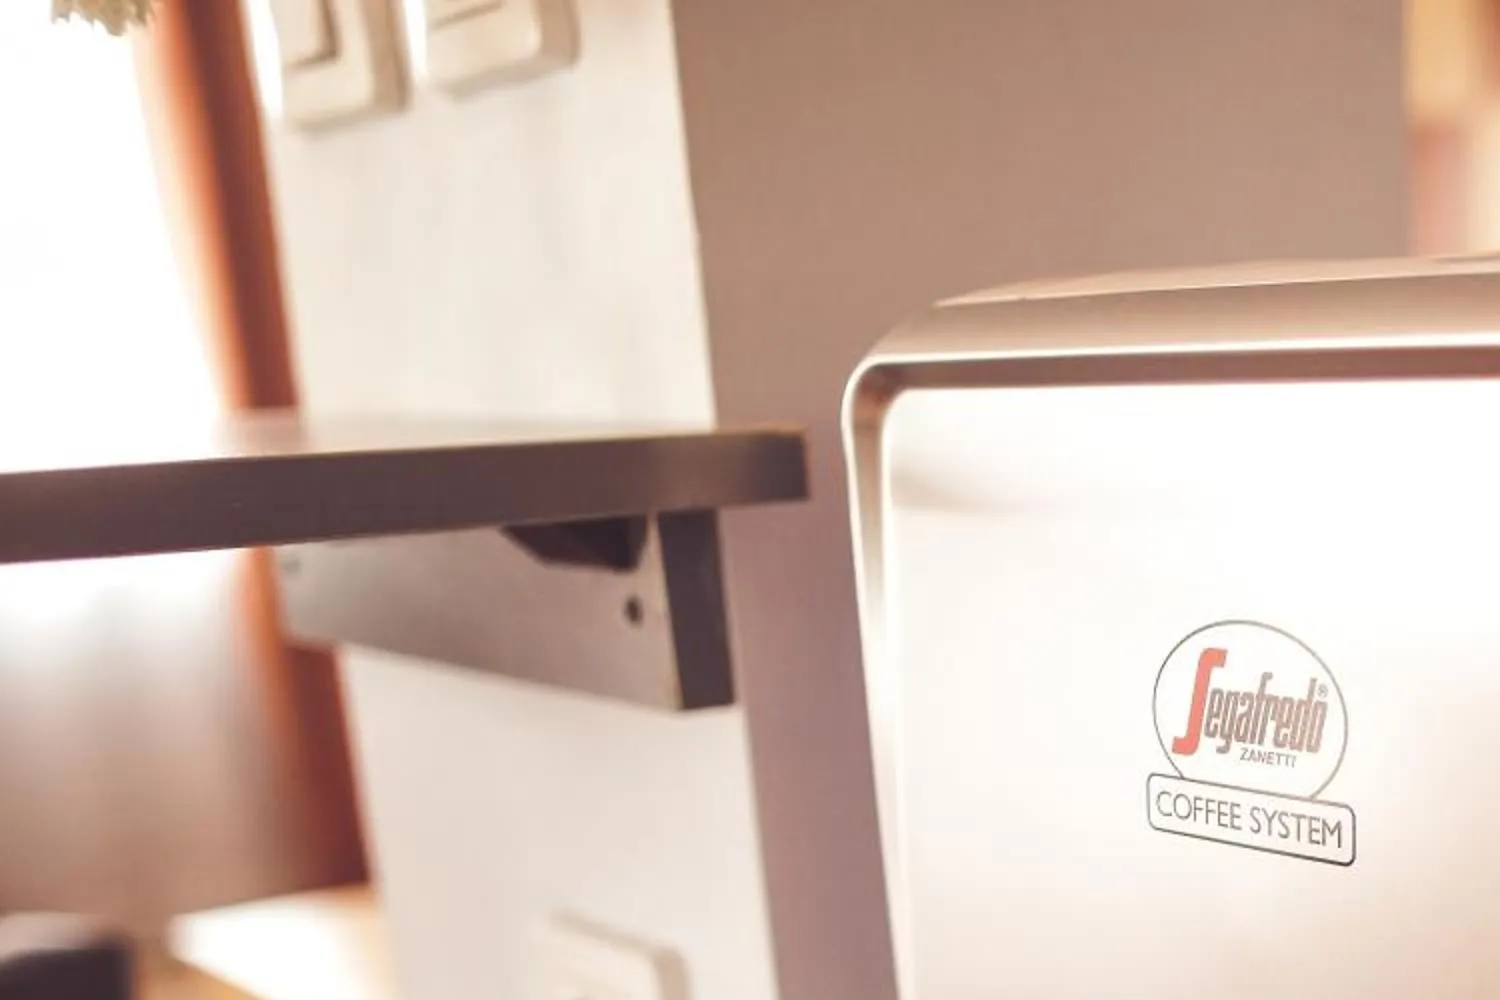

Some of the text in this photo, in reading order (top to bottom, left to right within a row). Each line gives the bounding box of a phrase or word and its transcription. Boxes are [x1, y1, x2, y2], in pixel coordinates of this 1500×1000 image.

[1239, 747, 1297, 768] ZANETTI
[1156, 790, 1343, 849] COFFEE SYSTEM
